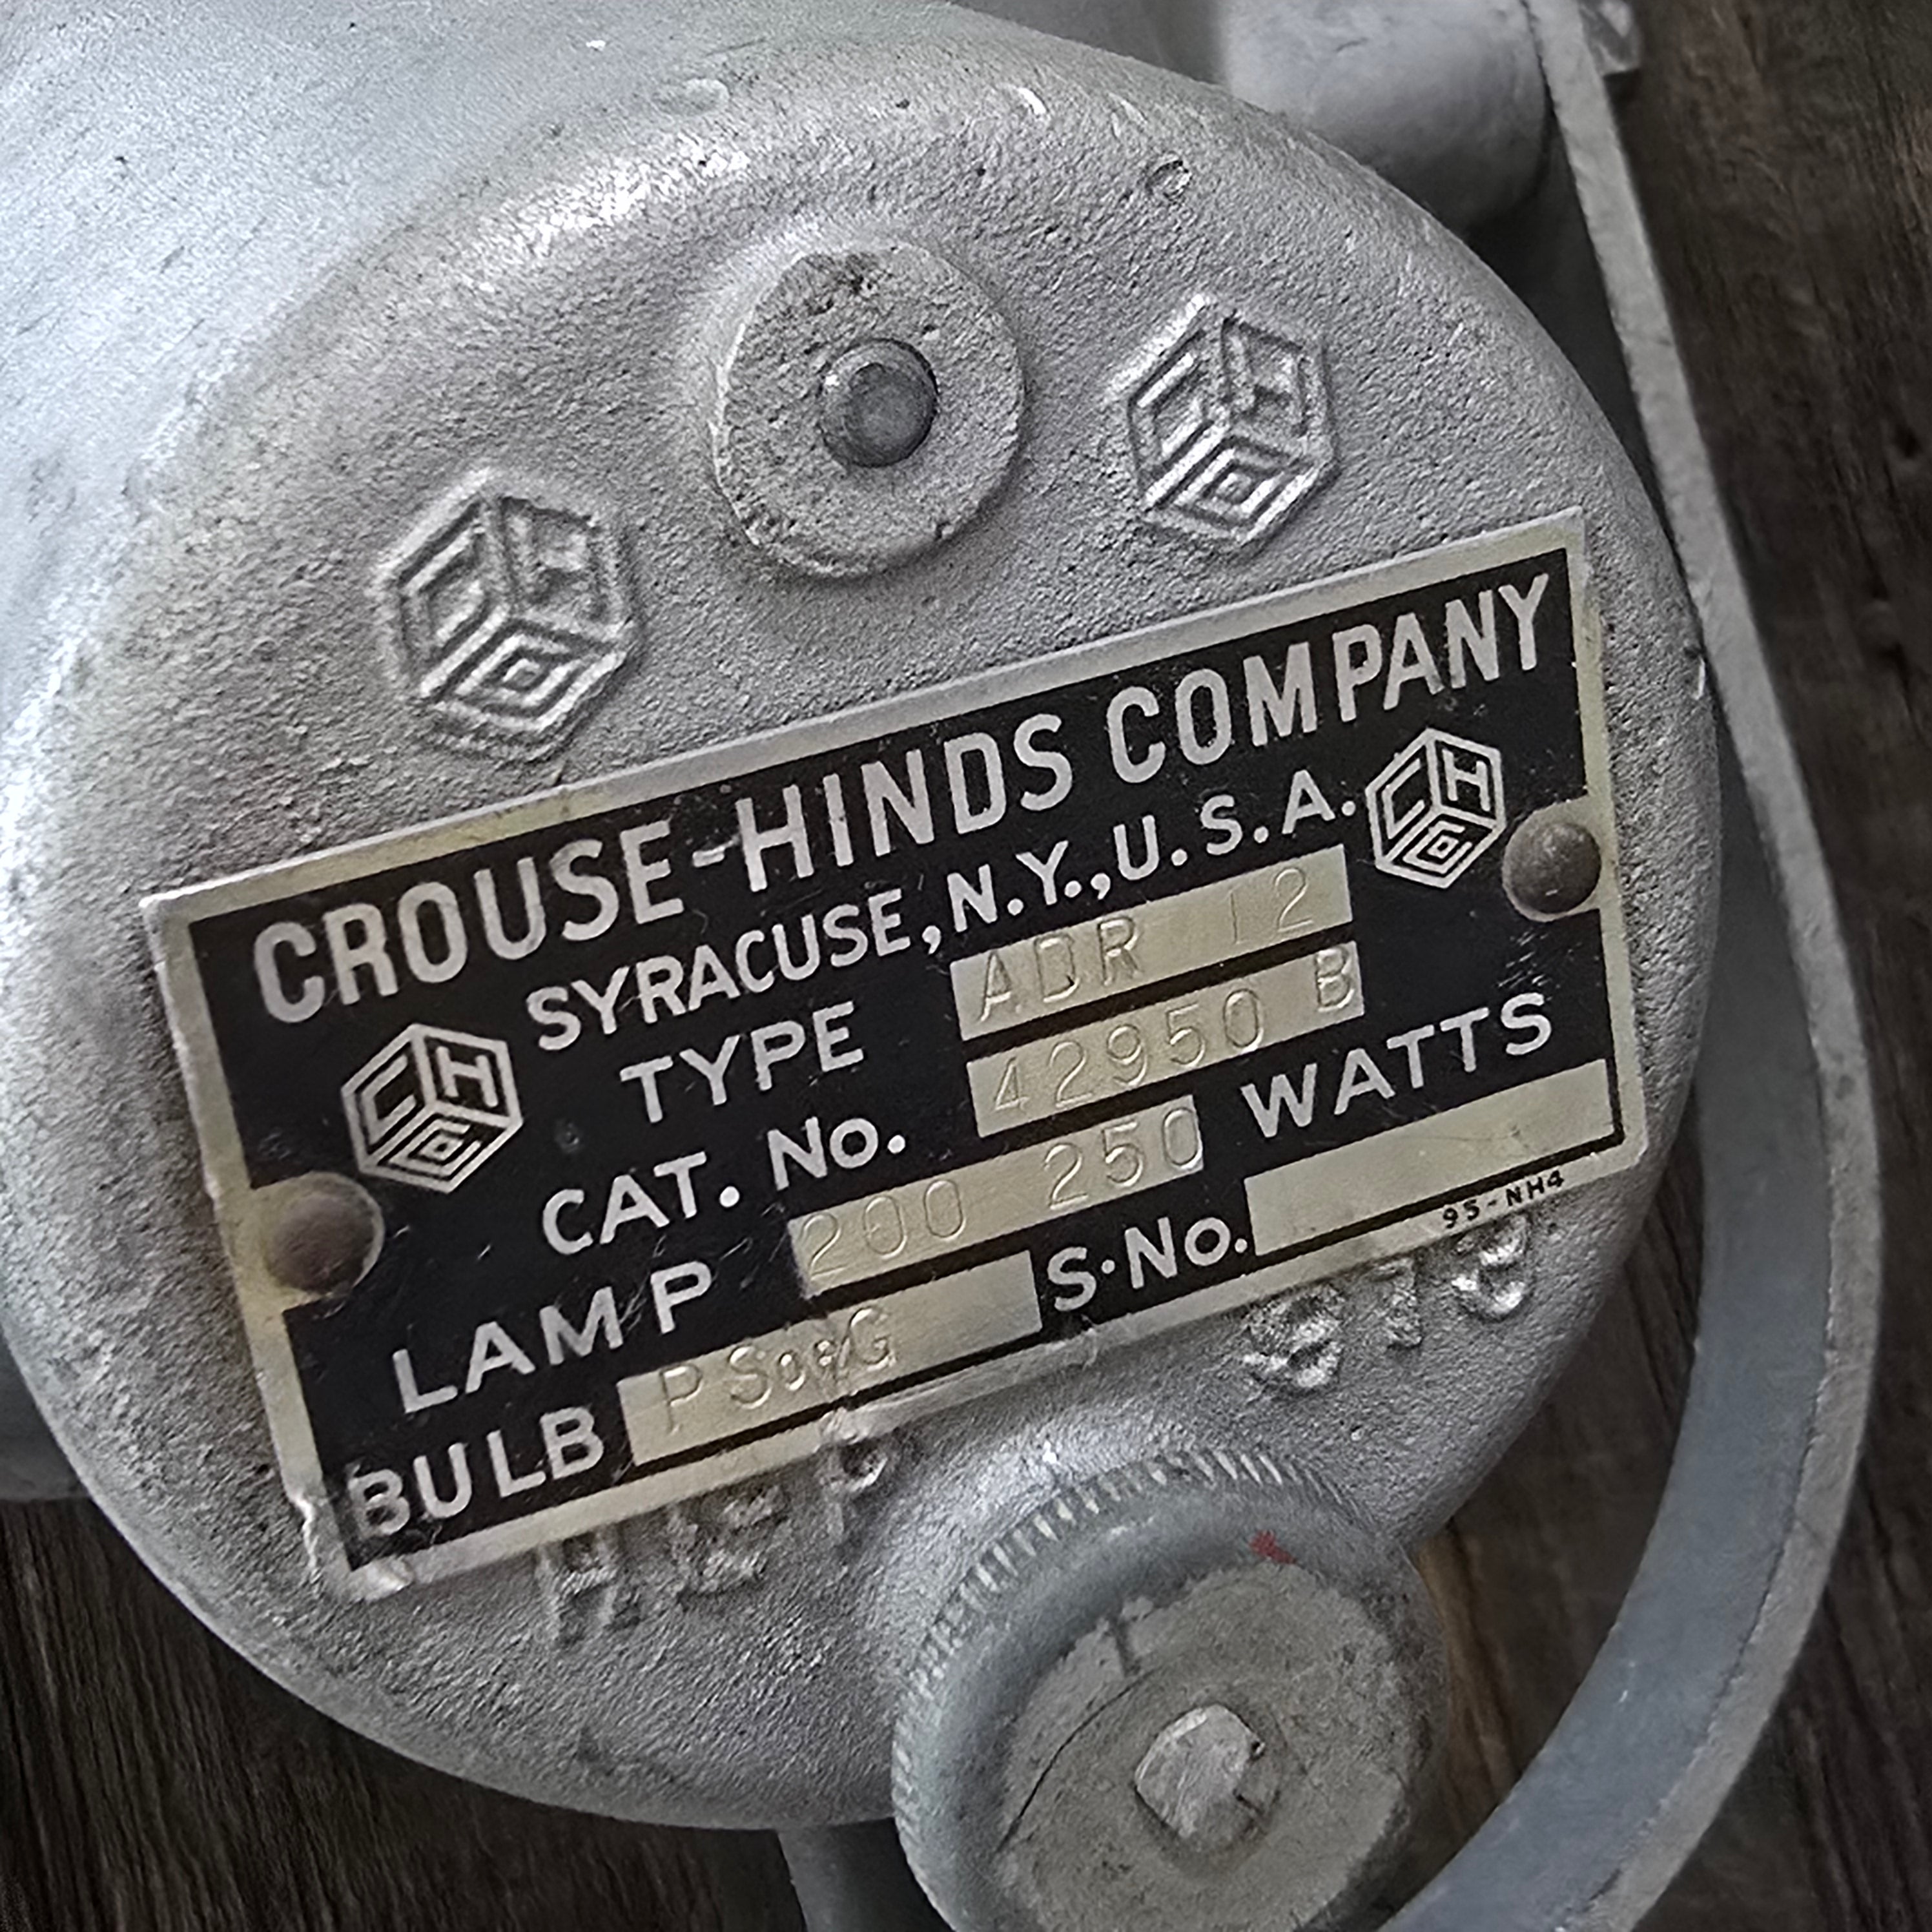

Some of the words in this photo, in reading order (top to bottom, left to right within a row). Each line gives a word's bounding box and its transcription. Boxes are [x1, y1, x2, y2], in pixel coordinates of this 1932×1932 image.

[253, 714, 1073, 1023] CROUSE-HINDS
[1106, 573, 1548, 783] COMPANY
[542, 1151, 740, 1255] CAT.
[995, 988, 1264, 1113] 42950
[1313, 946, 1355, 1012] B
[620, 1001, 865, 1122] TYPE
[978, 915, 1142, 1022] ADR
[1229, 868, 1315, 945] 12
[392, 1260, 713, 1413] LAMP
[799, 1179, 967, 1280] 200
[1044, 1107, 1204, 1210] 250
[1240, 992, 1552, 1138] WATTS
[347, 1406, 604, 1537] BULB
